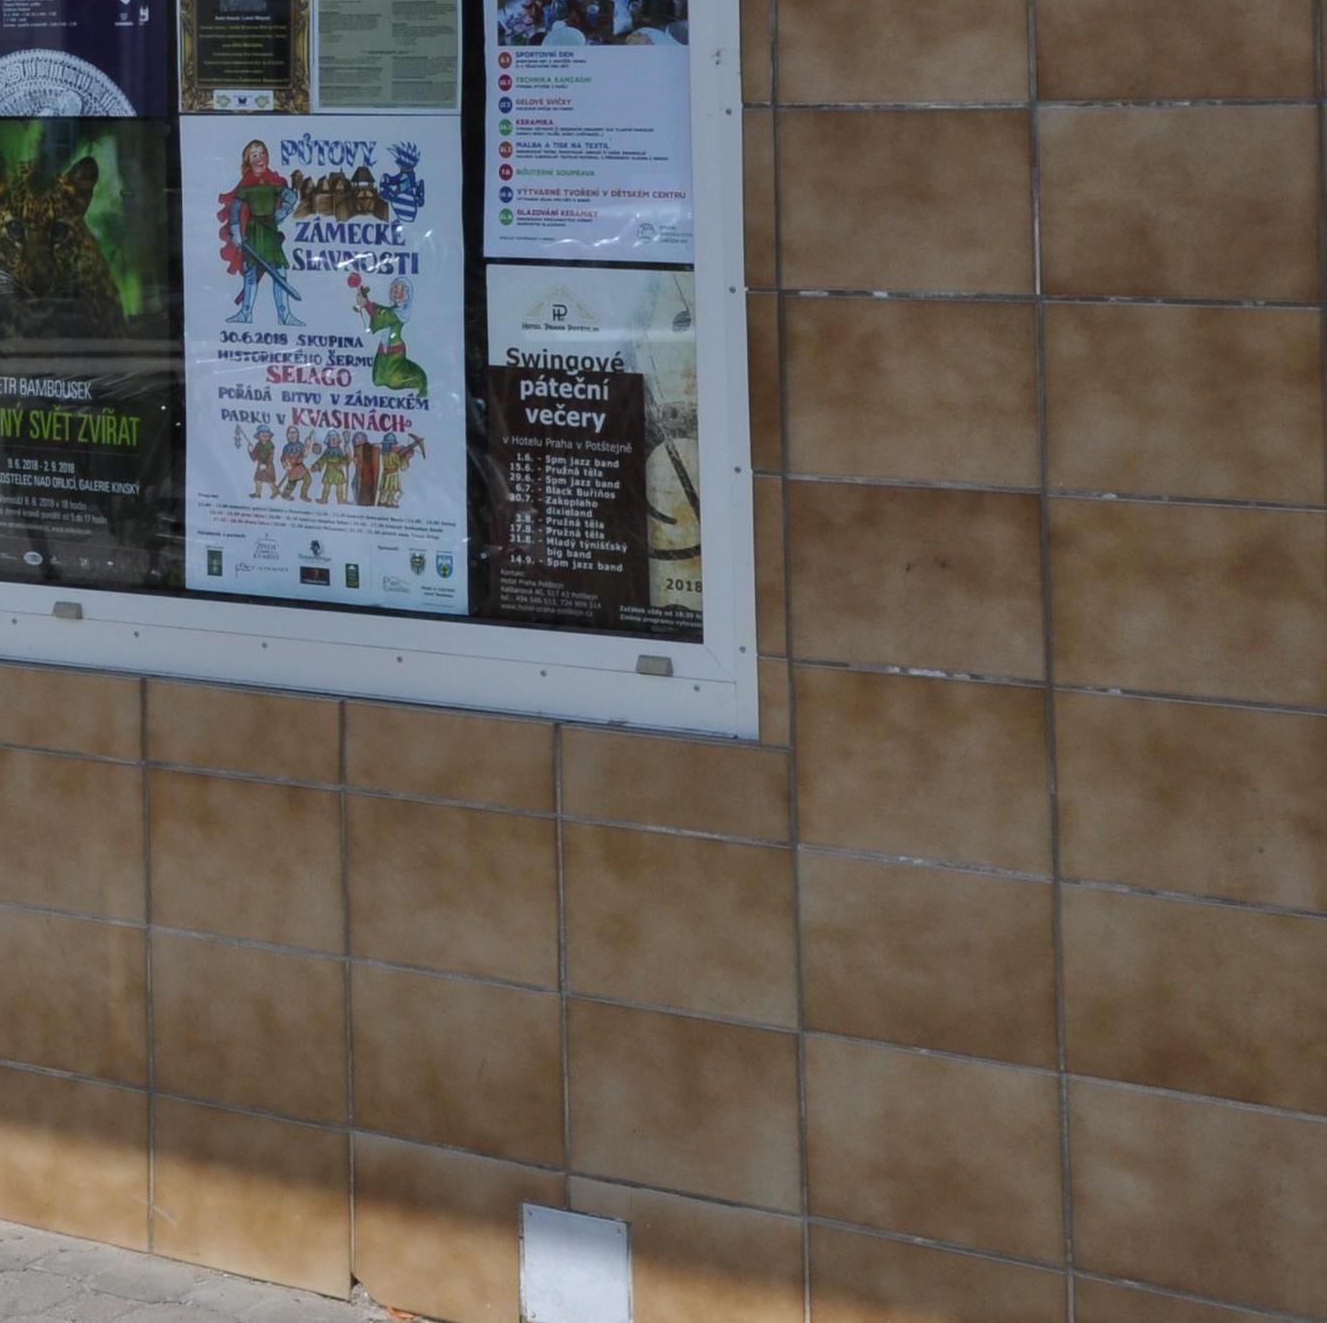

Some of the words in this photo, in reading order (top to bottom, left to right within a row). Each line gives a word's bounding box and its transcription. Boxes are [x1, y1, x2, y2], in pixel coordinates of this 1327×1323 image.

[516, 141, 542, 149] MALBA
[295, 218, 405, 246] ZÁMECKÉ
[292, 248, 419, 275] SLAVNOSTI
[219, 331, 288, 346] 30.6.2018
[296, 334, 364, 348] SKUPINA
[218, 349, 323, 365] HISTORICKÉHO
[326, 350, 374, 367] ŠERMU
[506, 347, 625, 375] Swingové
[266, 365, 352, 387] SELAGO
[20, 377, 92, 401] BAMBOUSEK
[520, 375, 609, 400] páteční
[218, 384, 272, 401] POŘÁDÁ
[282, 389, 321, 405] BITVU
[345, 390, 429, 410] ZÁMECKÉM
[221, 409, 270, 425] PARKU
[276, 413, 286, 425] V
[525, 404, 606, 433] večery
[30, 404, 72, 442] SVĚT
[77, 407, 140, 447] ZVÍŘAT
[511, 436, 543, 448] Hotelu
[545, 438, 573, 450] Praha
[585, 440, 632, 454] Potštejně
[570, 457, 590, 466] jazz
[594, 459, 620, 468] band
[545, 466, 579, 477] Pružná
[583, 468, 603, 477] těla
[34, 475, 51, 487] NAD
[78, 480, 110, 493] GALERIE
[111, 480, 141, 496] KINSKÝ
[515, 483, 534, 492] 6.7.
[546, 486, 572, 496] Black
[570, 478, 591, 487] jazz
[595, 479, 620, 489] band
[546, 507, 593, 517] dixieland
[546, 517, 580, 527] Pružná
[585, 520, 605, 529] těla
[546, 527, 580, 538] Pružná
[585, 530, 605, 539] těla
[546, 538, 576, 548] Mladý
[546, 548, 563, 558] big
[566, 549, 592, 559] band
[572, 560, 593, 569] jazz
[598, 562, 623, 572] band
[666, 578, 702, 593] 2018
